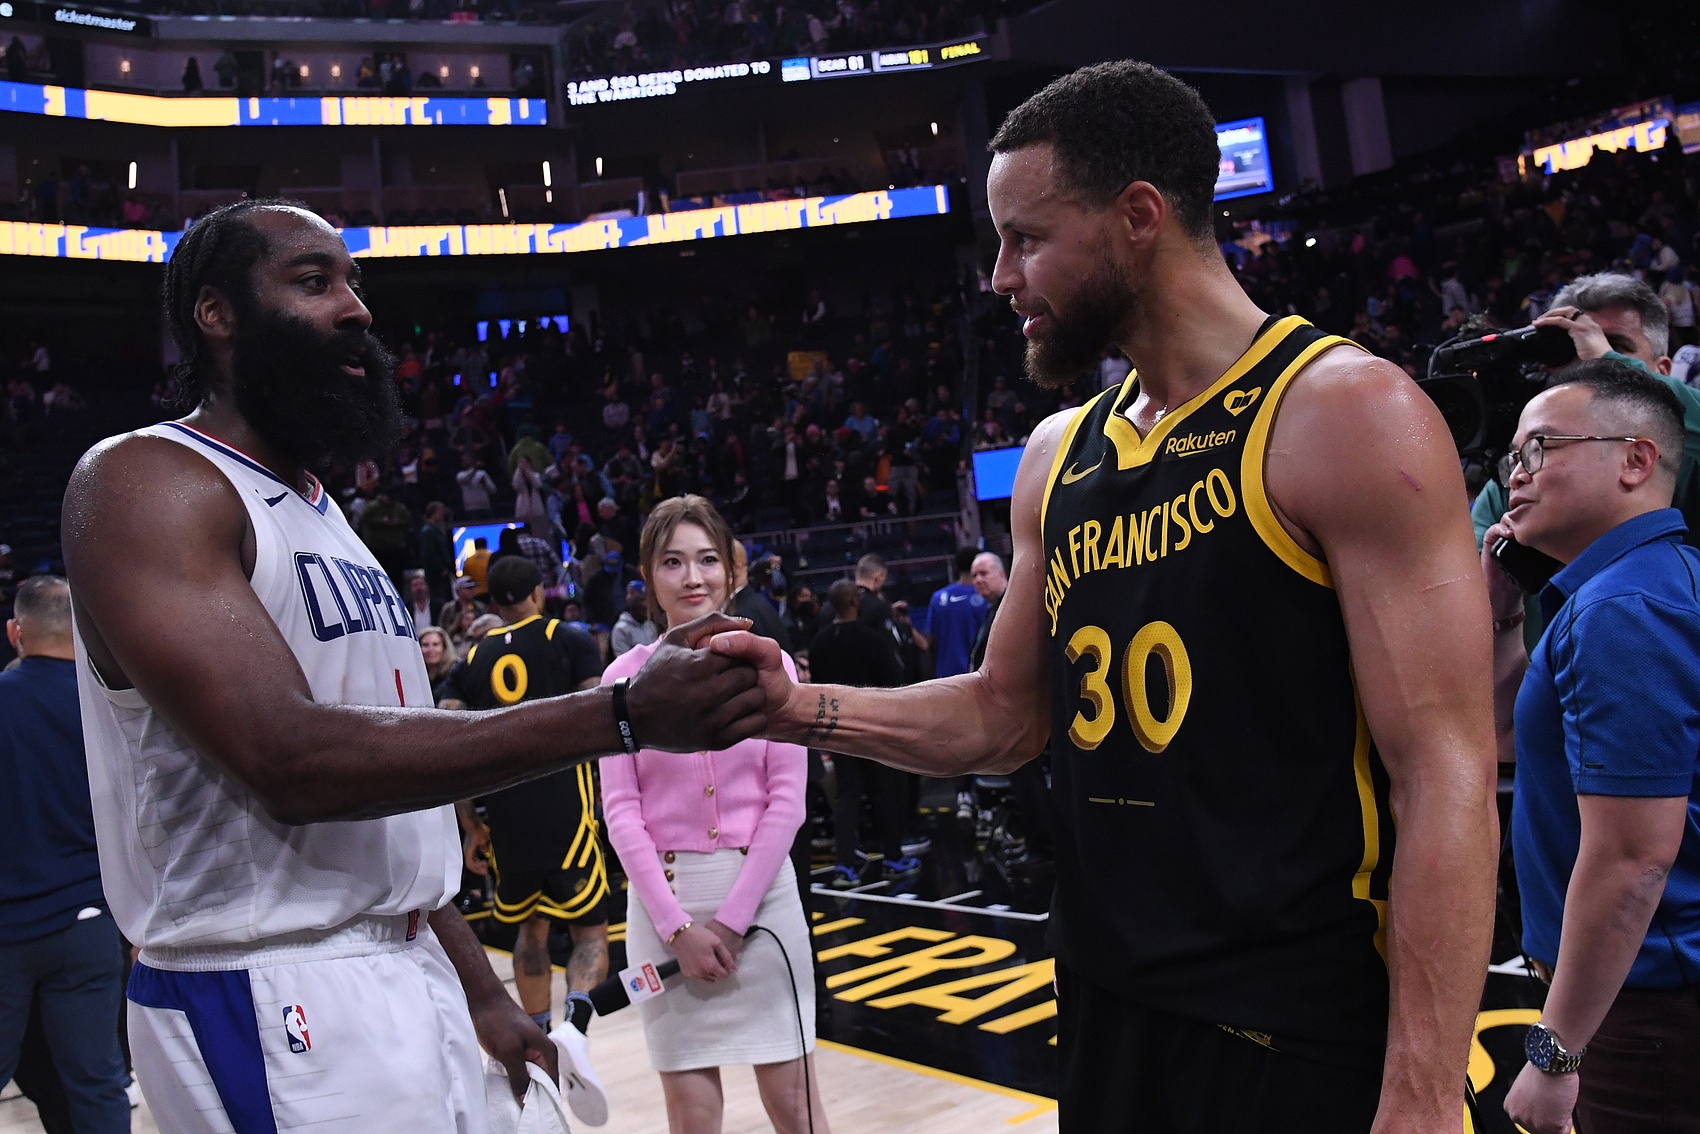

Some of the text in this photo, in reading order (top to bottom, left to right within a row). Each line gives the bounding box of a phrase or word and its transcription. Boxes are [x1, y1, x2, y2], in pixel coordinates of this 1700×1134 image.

[55, 9, 136, 31] ticketmaster
[908, 49, 929, 65] 101
[940, 42, 981, 60] FINAL
[578, 78, 608, 93] AND
[638, 70, 683, 87] BEING
[684, 63, 750, 82] DONATED
[750, 61, 771, 75] TO
[567, 83, 677, 105] THE WARRIORS
[1165, 429, 1237, 456] Rakuten
[1044, 468, 1237, 638] SAN FRANCISCO
[490, 653, 528, 702] 0
[1064, 620, 1193, 754] 30
